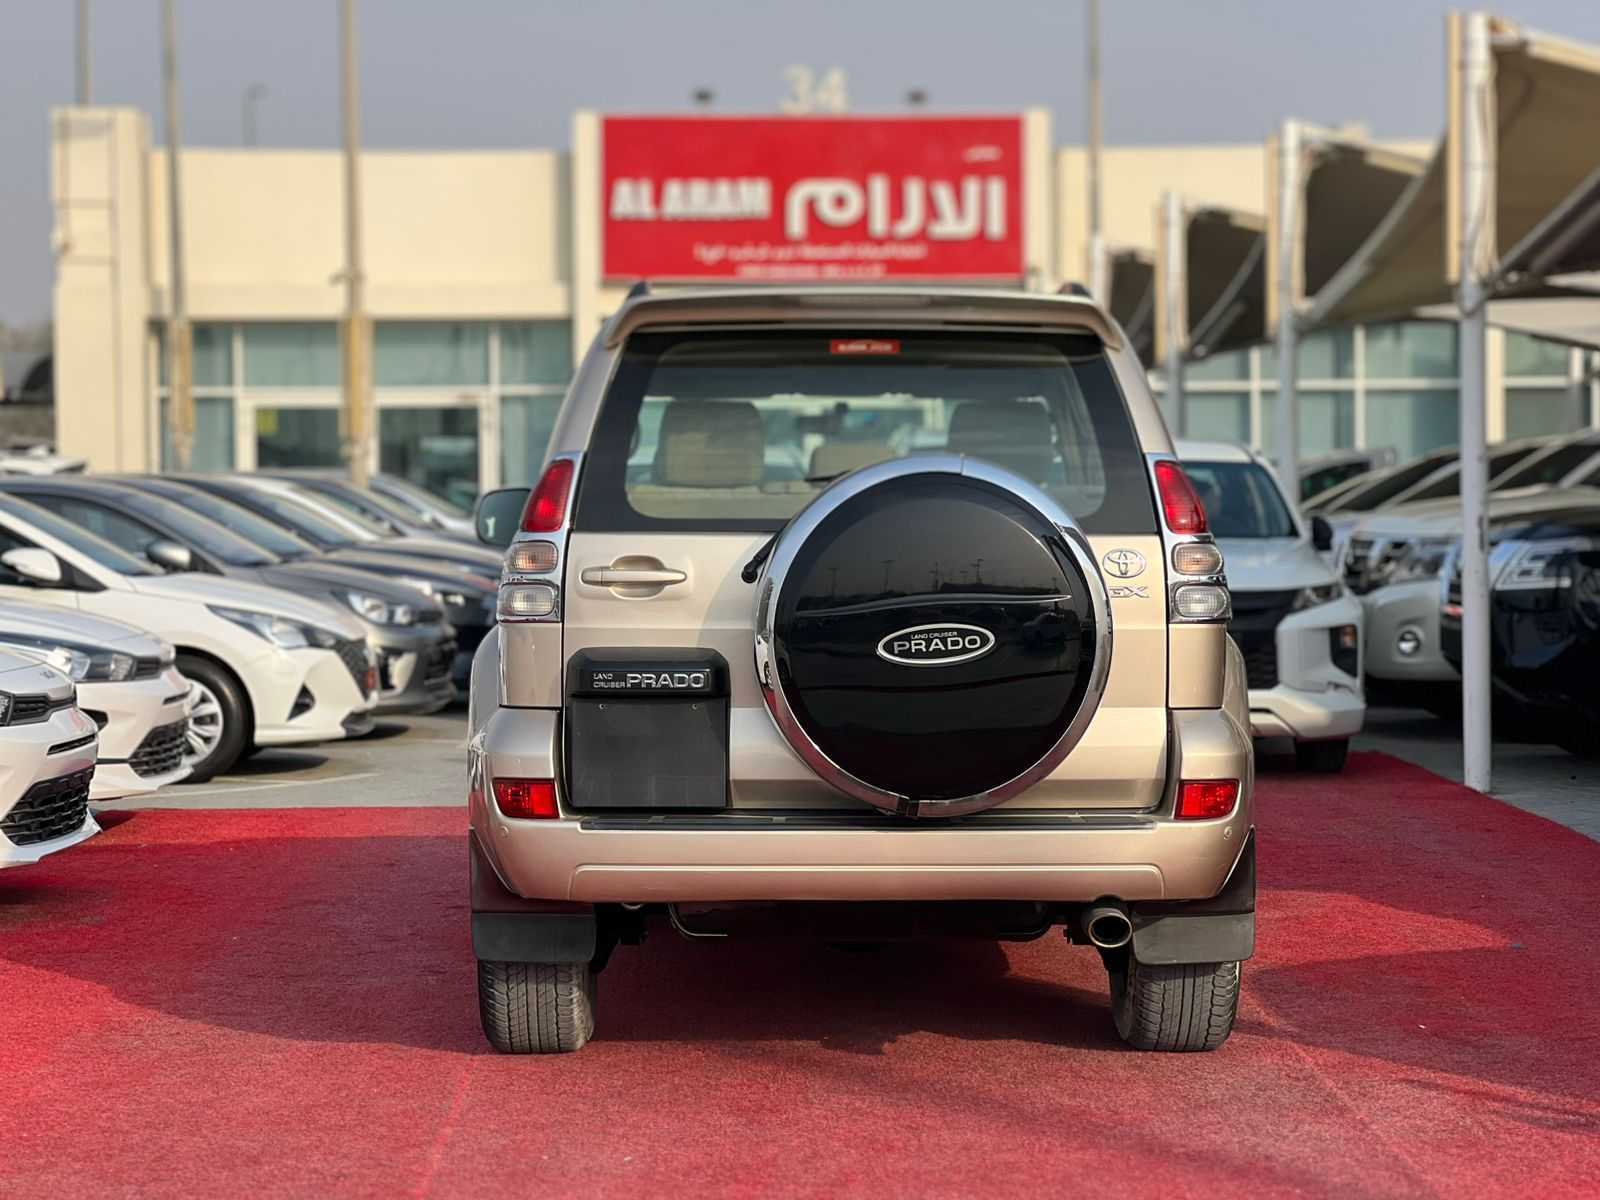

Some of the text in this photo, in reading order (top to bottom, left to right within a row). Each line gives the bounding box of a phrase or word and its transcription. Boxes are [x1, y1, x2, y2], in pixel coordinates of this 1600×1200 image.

[611, 177, 657, 220] AL
[911, 631, 958, 640] LAND CRUISER
[893, 635, 981, 654] PRADO
[626, 673, 705, 688] PRADO
